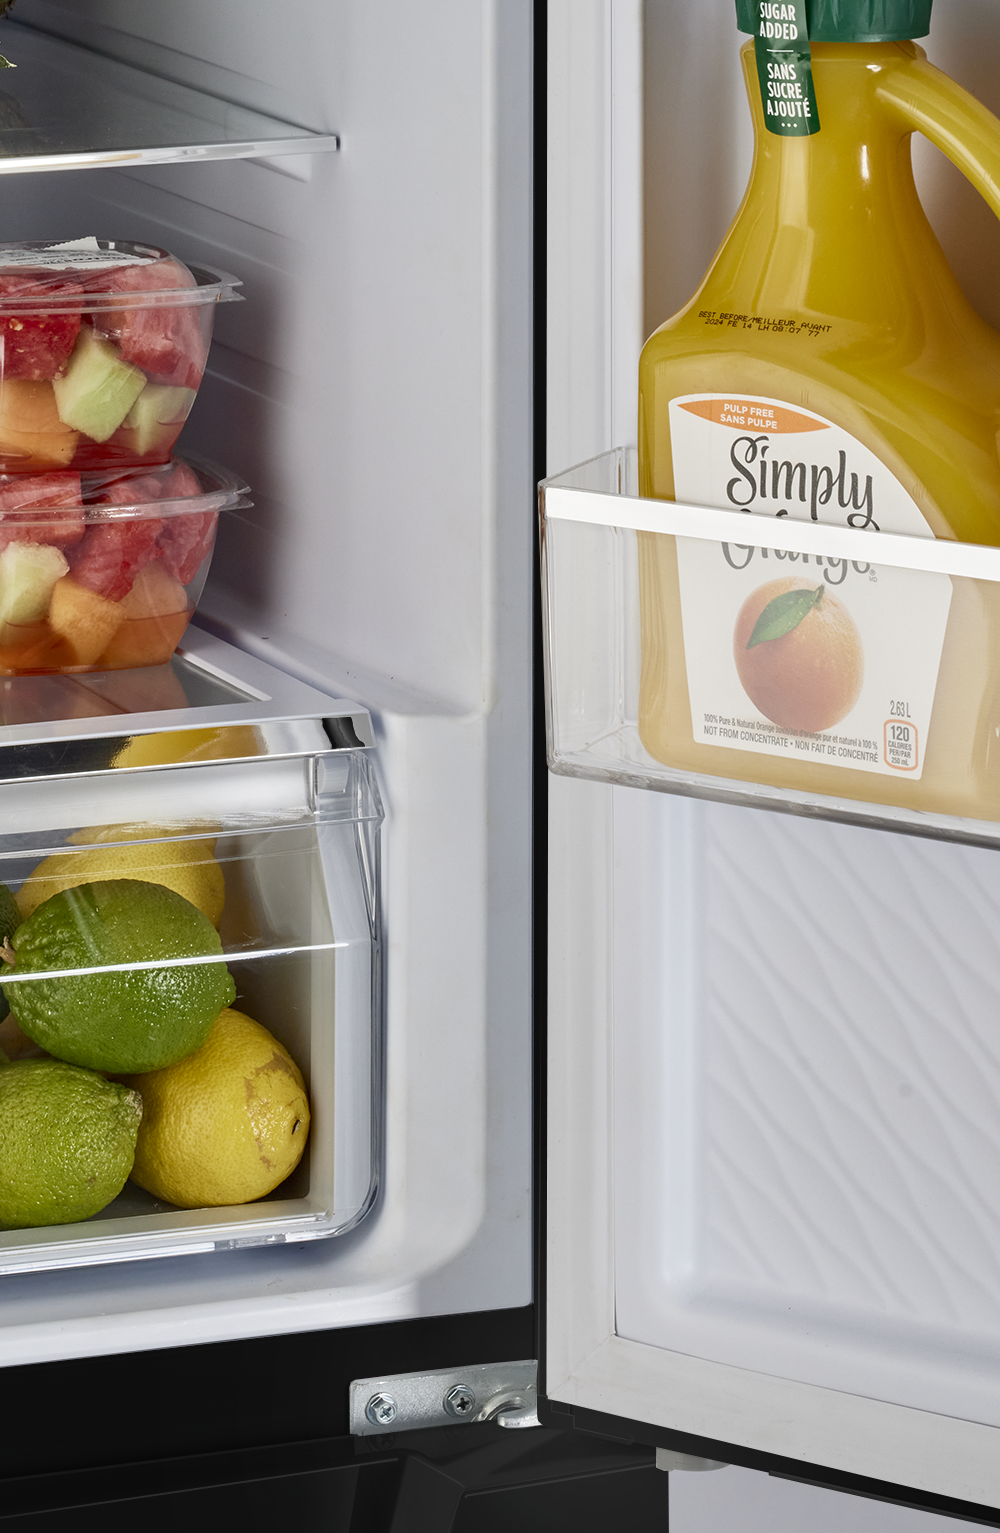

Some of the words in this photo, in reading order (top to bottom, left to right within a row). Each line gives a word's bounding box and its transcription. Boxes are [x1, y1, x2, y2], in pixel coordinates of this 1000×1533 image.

[760, 2, 796, 21] SUGAR
[760, 21, 798, 40] ADDED
[767, 63, 796, 80] SANS
[767, 82, 803, 99] SUCRE
[767, 97, 811, 117] AJOUTÉ
[720, 313, 796, 327] BEFORE/MEILLEUR
[801, 322, 832, 333] AVANT
[772, 326, 801, 334] 08:07
[724, 404, 748, 414] PULP
[750, 407, 774, 418] FREE
[720, 414, 746, 425] SANS
[748, 417, 778, 429] PULPE
[727, 436, 880, 531] Simply
[890, 700, 905, 716] 2.63
[906, 703, 911, 718] L
[891, 725, 909, 742] 120
[704, 725, 718, 735] NOT
[719, 727, 739, 739] FROM
[740, 731, 788, 747] CONCENTRATE
[795, 740, 810, 751] NON
[811, 743, 826, 753] FAIT
[827, 746, 837, 756] DE
[838, 748, 878, 763] CONCENTRÉ
[888, 740, 912, 751] CALORIES
[889, 749, 911, 758] PER/PAR
